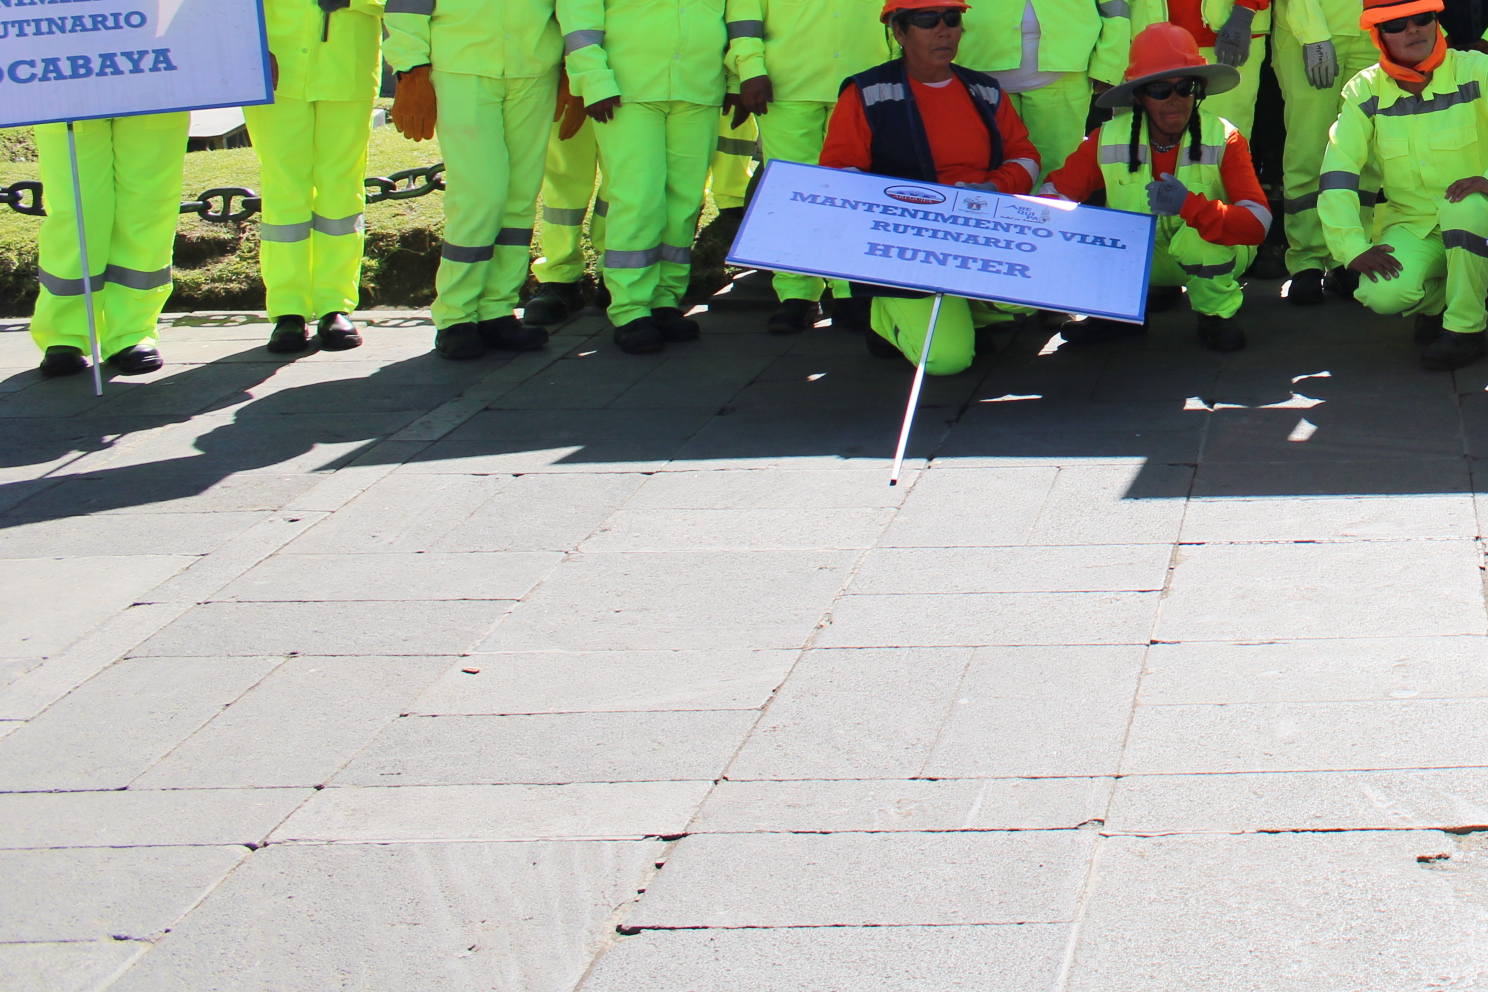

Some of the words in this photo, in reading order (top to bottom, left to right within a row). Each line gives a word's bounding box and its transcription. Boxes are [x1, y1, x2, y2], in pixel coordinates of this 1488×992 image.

[0, 10, 147, 39] UTINARIO
[789, 191, 1053, 238] MANTENIMIENTO
[1058, 230, 1126, 249] VIAL
[869, 219, 1037, 252] RUTINARIO
[863, 241, 1031, 278] HUNTER
